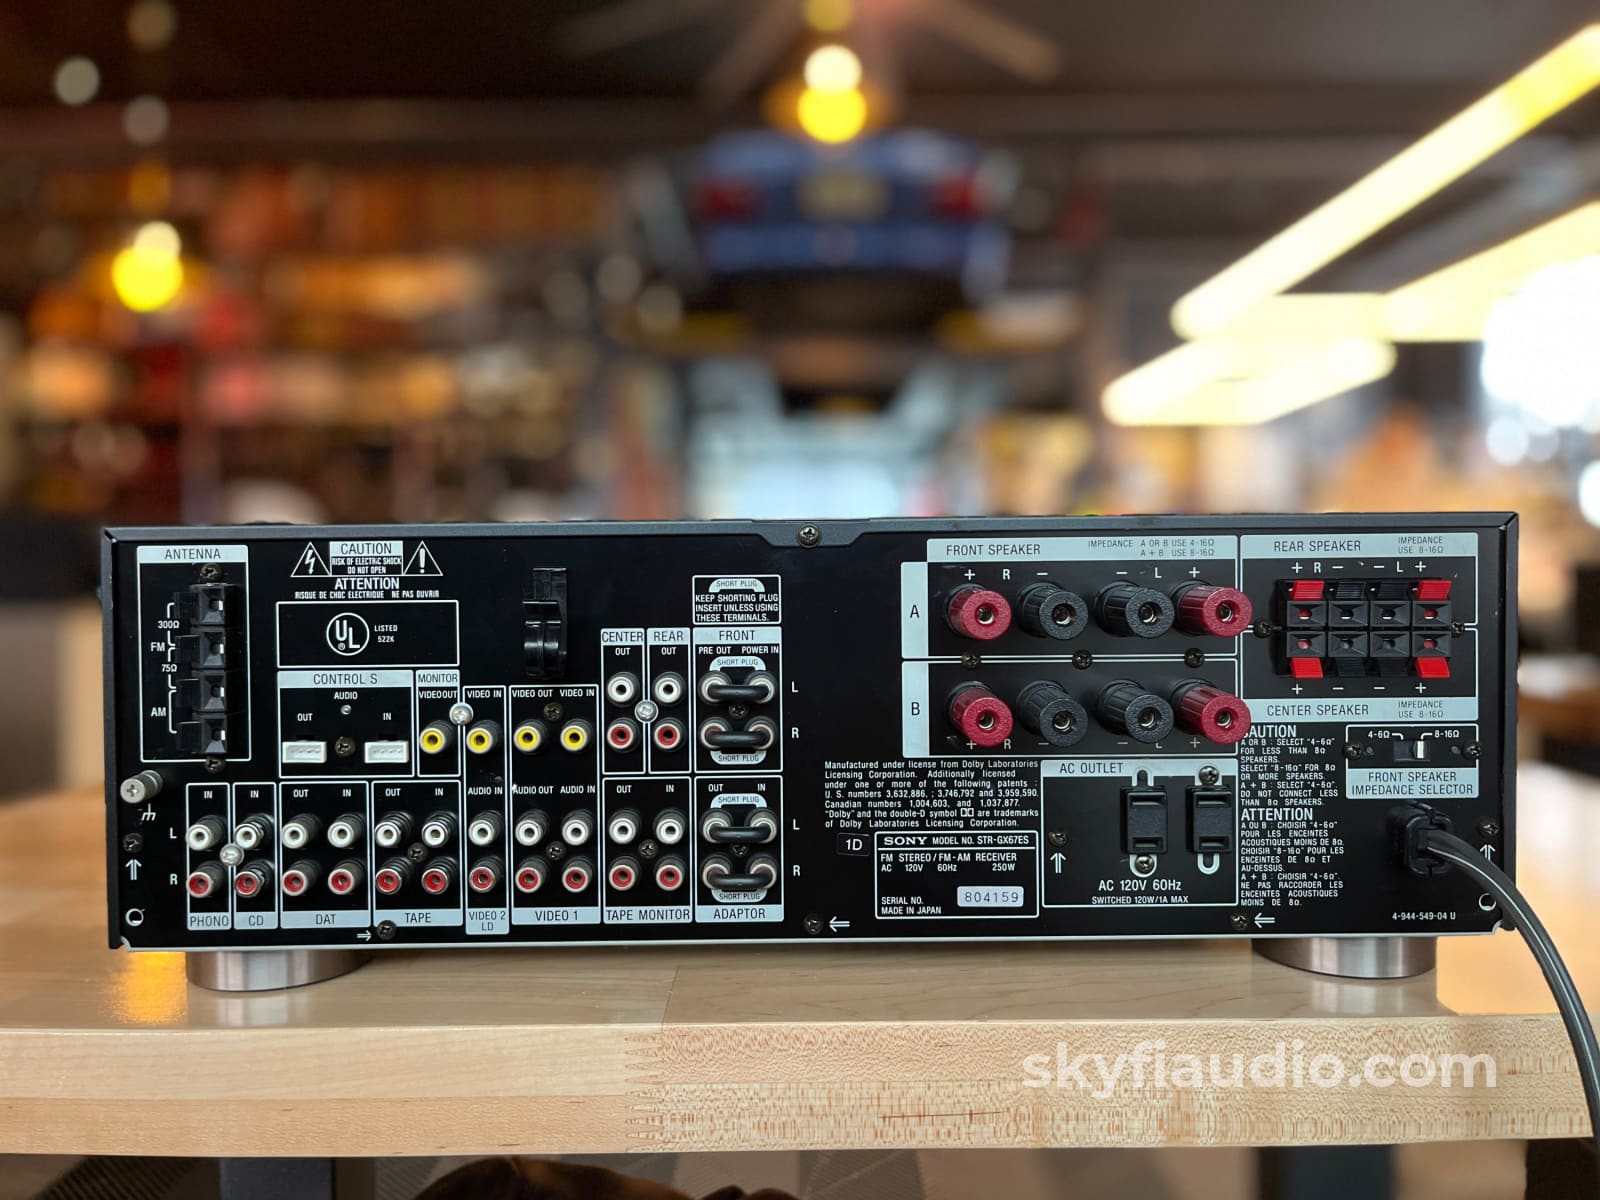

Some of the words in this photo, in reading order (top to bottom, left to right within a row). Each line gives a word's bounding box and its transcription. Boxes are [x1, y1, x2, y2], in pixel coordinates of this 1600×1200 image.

[1088, 540, 1133, 548] IMPEDANCE
[1399, 536, 1442, 544] IMPEDANCE
[341, 543, 392, 554] CAUTION
[946, 544, 985, 556] FRONT
[989, 544, 1041, 556] SPEAKER
[1274, 541, 1304, 552] REAR
[1309, 541, 1361, 552] SPEAKER
[165, 548, 221, 560] ANTENNA
[383, 557, 401, 565] SHOCK
[348, 566, 355, 574] DO
[357, 566, 369, 574] NOT
[371, 566, 386, 574] OPEN
[335, 577, 400, 590] ATTENTION
[696, 594, 713, 602] KEEP
[718, 594, 756, 602] SHORTING
[759, 594, 778, 602] PLUG
[696, 604, 722, 612] INSERT
[724, 604, 753, 612] UNLESS
[755, 604, 778, 612] USING
[910, 605, 920, 618] A
[696, 614, 720, 622] THESE
[158, 620, 179, 629] 300Ω
[602, 632, 643, 642] CENTER
[654, 631, 683, 641] REAR
[719, 630, 755, 640] FRONT
[151, 642, 165, 652] FM
[662, 647, 676, 655] OUT
[742, 646, 769, 654] POWER
[771, 646, 779, 654] IN
[161, 664, 177, 672] 75Ω
[313, 673, 366, 684] CONTROL
[370, 673, 378, 684] S
[418, 674, 458, 682] MONITOR
[444, 690, 457, 698] OUT
[467, 690, 490, 698] VIDEO
[494, 690, 501, 698] IN
[151, 707, 166, 717] AM
[911, 702, 920, 716] B
[1267, 704, 1312, 716] CENTER
[1317, 704, 1369, 716] SPEAKER
[298, 713, 312, 721] OUT
[1244, 725, 1297, 738] AUTION
[718, 754, 739, 762] SHORT
[743, 754, 759, 762] PLUG
[825, 760, 878, 769] Manufactured
[883, 760, 904, 769] under
[908, 760, 937, 769] license
[940, 760, 958, 769] from
[962, 760, 984, 769] Dolby
[988, 760, 1038, 769] Laboratories
[1060, 762, 1075, 774] AC
[1081, 762, 1123, 774] OUTLET
[825, 770, 862, 779] Licensing
[869, 770, 917, 779] Corporation.
[927, 770, 975, 779] Additionally
[982, 770, 1015, 779] licensed
[1369, 772, 1403, 782] FRONT
[1408, 772, 1457, 782] SPEAKER
[385, 788, 400, 796] OUT
[435, 788, 443, 796] IN
[468, 787, 491, 795] AUDIO
[495, 787, 502, 795] IN
[512, 786, 536, 794] AUDIO
[539, 786, 554, 794] OUT
[560, 786, 584, 794] AUDIO
[587, 786, 595, 794] IN
[617, 785, 632, 793] OUT
[708, 784, 724, 792] OUT
[1352, 784, 1414, 794] IMPEDANCE
[1419, 784, 1473, 794] SELECTOR
[250, 790, 259, 798] IN
[293, 789, 308, 797] OUT
[1241, 808, 1313, 821] ATTENTION
[825, 819, 833, 828] of
[840, 819, 861, 828] Dolby
[869, 819, 919, 828] Laboratories
[926, 819, 964, 828] Licensing
[970, 819, 1019, 828] Corporation.
[170, 828, 177, 839] L
[845, 839, 862, 850] 1D
[884, 837, 927, 845] SONY
[932, 837, 959, 845] MODEL
[961, 837, 974, 845] NO.
[977, 836, 1029, 844] STR-GX67ES
[881, 853, 893, 862] FM
[975, 853, 1017, 862] RECEIVER
[881, 863, 892, 872] AC
[905, 863, 923, 872] 120V
[938, 863, 957, 872] 60Hz
[992, 863, 1015, 872] 250W
[170, 874, 178, 885] R
[1098, 879, 1114, 891] AC
[1120, 879, 1147, 891] 120V
[1153, 879, 1181, 891] 60Hz
[965, 892, 1018, 903] 804159
[1092, 896, 1131, 904] SWITCHED
[1134, 896, 1168, 904] 120W/1A
[1171, 896, 1188, 904] MAX
[405, 912, 431, 923] TAPE
[469, 911, 496, 920] VIDEO
[500, 911, 506, 920] 2
[535, 911, 568, 921] VIDEO
[573, 911, 578, 921] 1
[607, 909, 632, 921] TAPE
[639, 909, 690, 921] MONITOR
[713, 908, 765, 919] ADAPTOR
[1392, 912, 1449, 920] 4-944-549-04
[190, 916, 229, 927] PHONO
[249, 915, 264, 926] CD
[315, 914, 336, 924] DAT
[482, 922, 493, 931] LD
